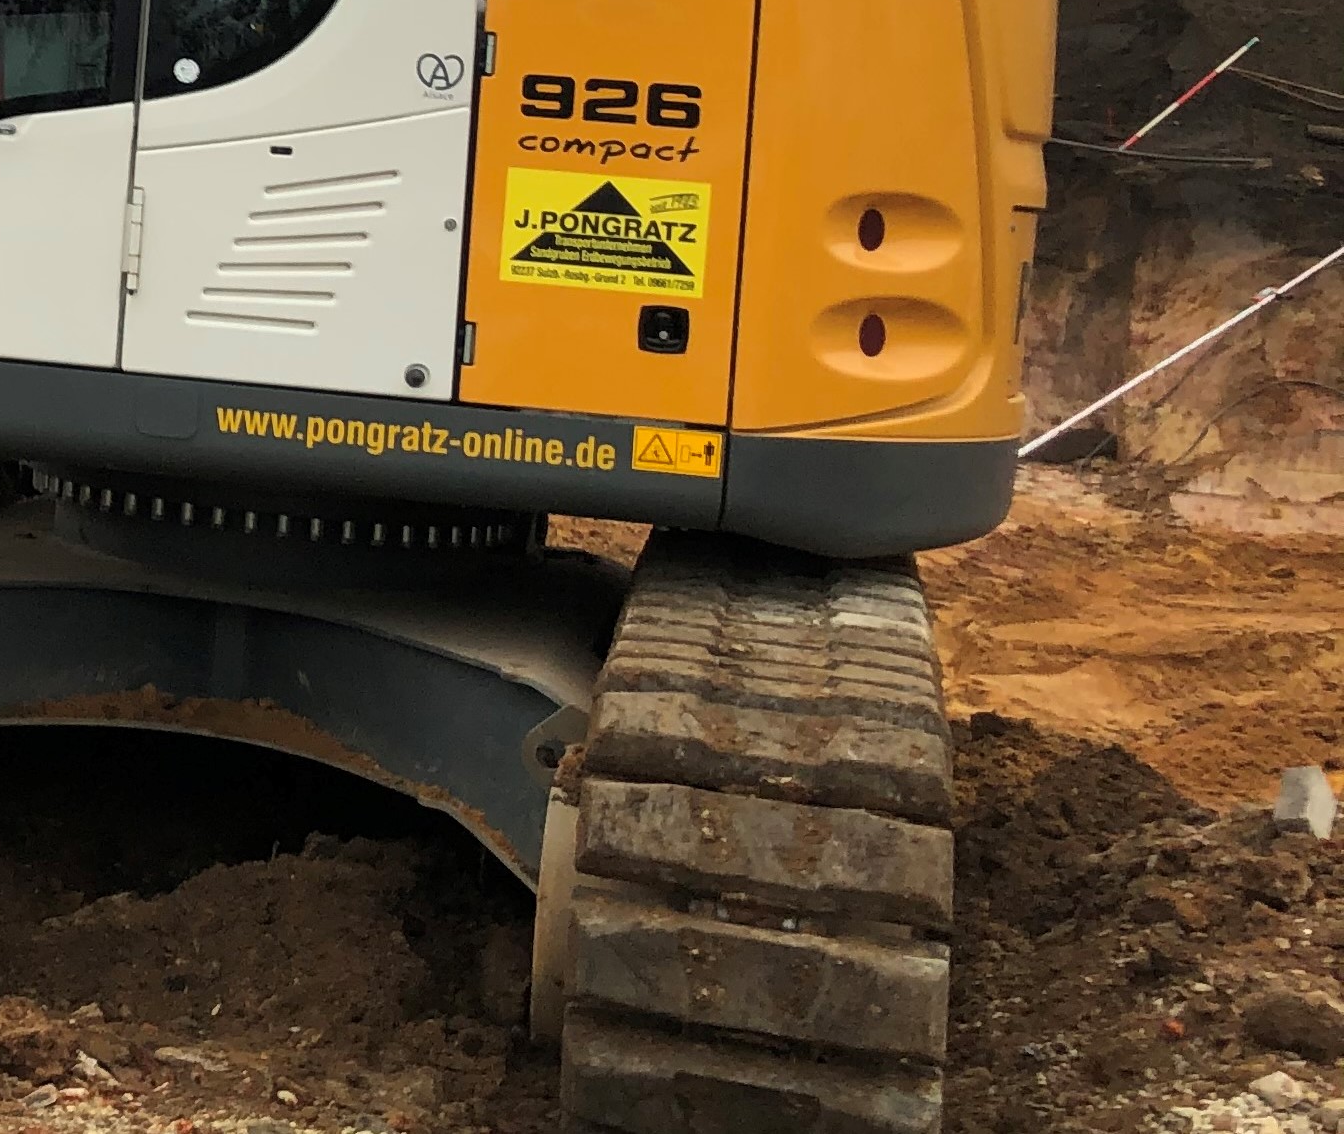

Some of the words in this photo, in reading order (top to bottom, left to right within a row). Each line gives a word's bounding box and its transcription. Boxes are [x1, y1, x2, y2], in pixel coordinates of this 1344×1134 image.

[520, 74, 702, 129] 926
[518, 135, 700, 165] compact
[514, 209, 698, 243] J.PONGRATZ
[216, 406, 616, 470] www.pongratz-online.de
